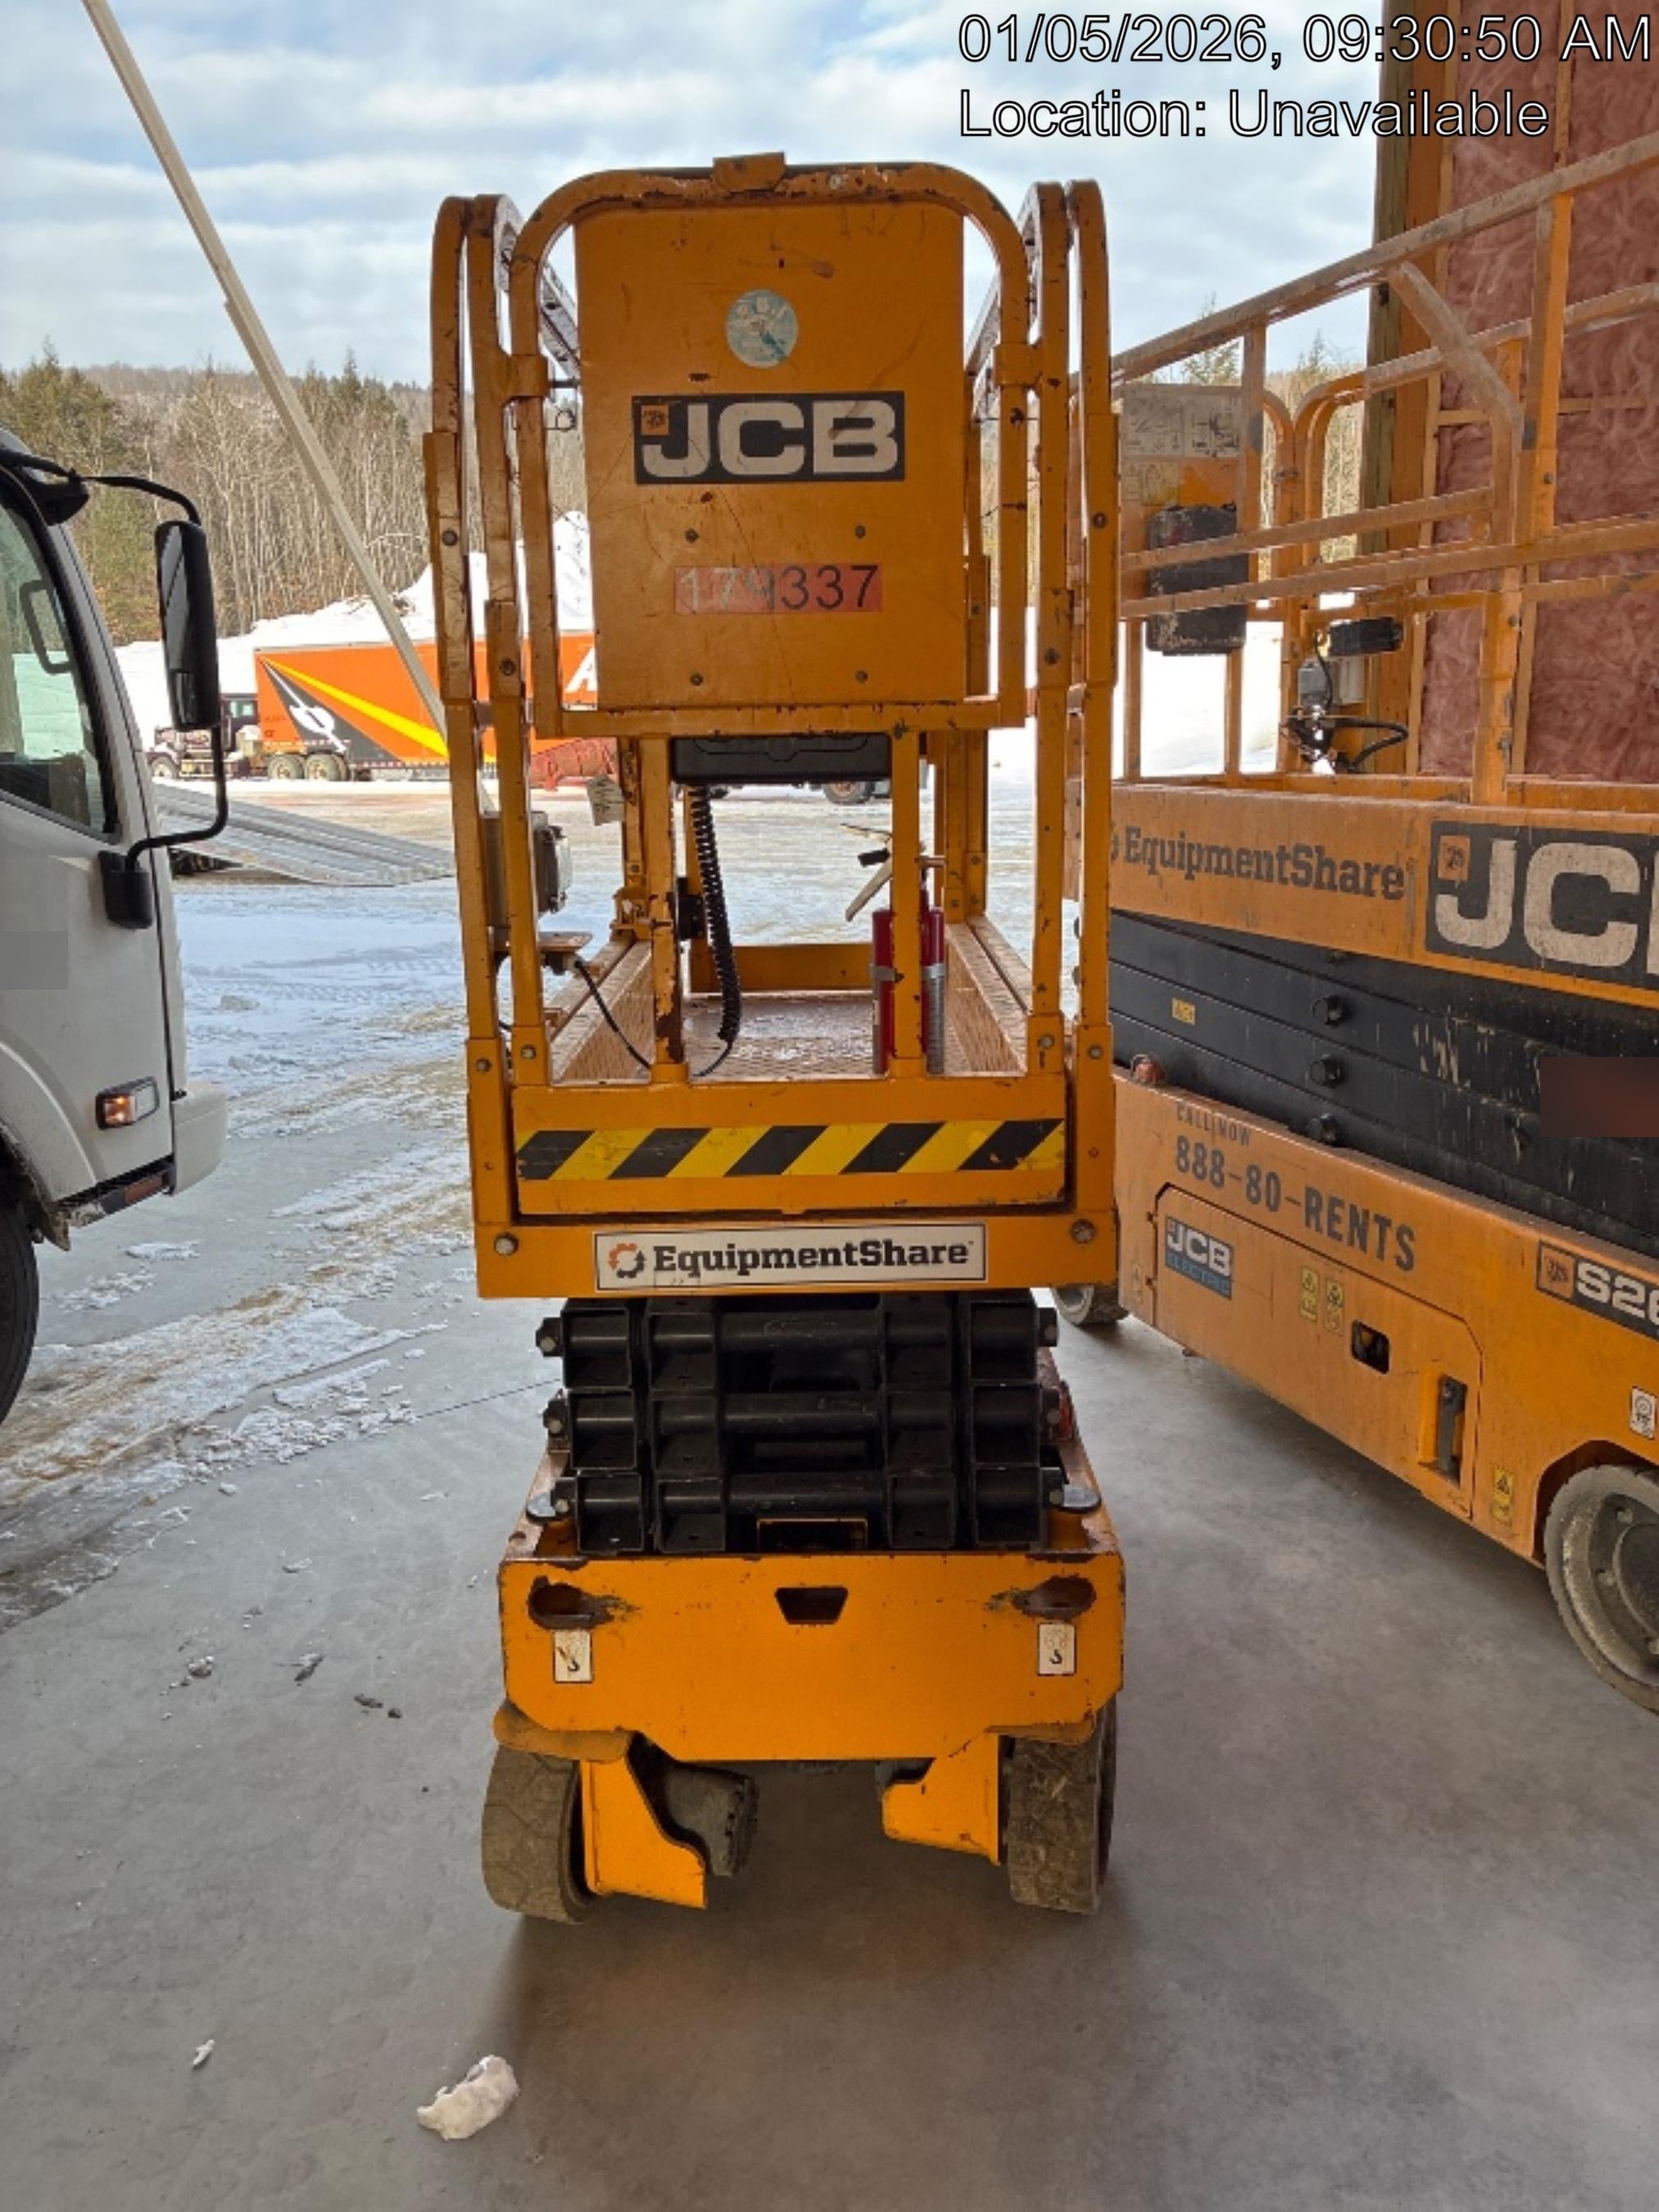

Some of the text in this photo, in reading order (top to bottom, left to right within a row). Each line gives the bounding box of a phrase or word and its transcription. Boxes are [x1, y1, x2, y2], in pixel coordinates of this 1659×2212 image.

[642, 400, 899, 478] JCB
[1125, 824, 1404, 900] EquipmentShare
[1435, 839, 1659, 975] JC
[1175, 1135, 1415, 1271] 888-80-RENTS
[653, 1238, 970, 1277] EquipmentShare
[1166, 1222, 1231, 1276] JCB
[1167, 1252, 1229, 1298] ELECTRIC
